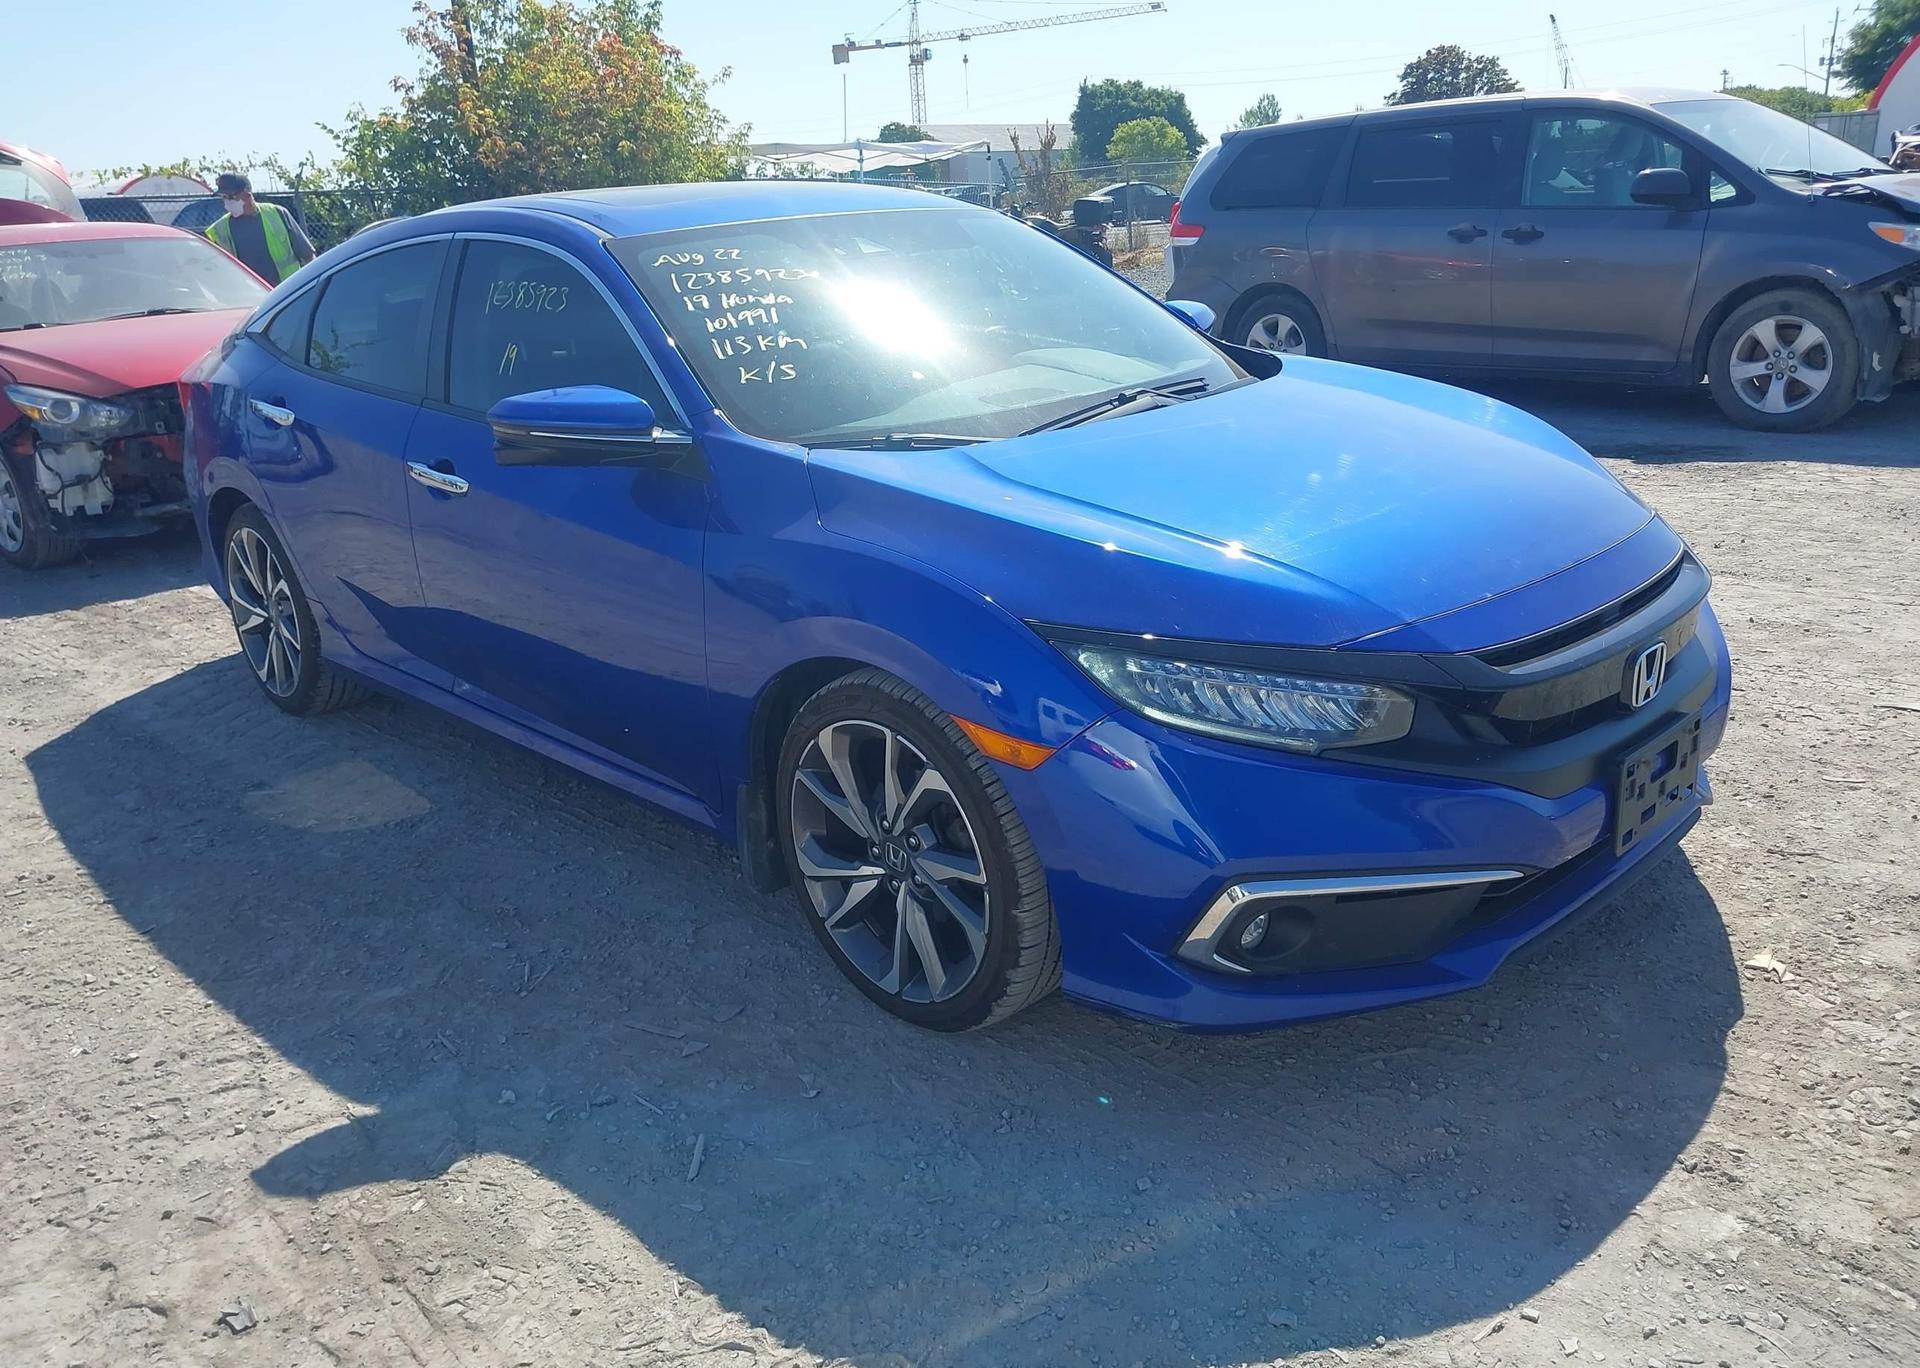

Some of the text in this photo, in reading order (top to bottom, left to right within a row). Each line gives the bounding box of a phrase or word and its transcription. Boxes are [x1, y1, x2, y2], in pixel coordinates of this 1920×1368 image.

[714, 248, 743, 260] 22
[683, 292, 794, 312] 19 Honda
[499, 342, 518, 376] 19
